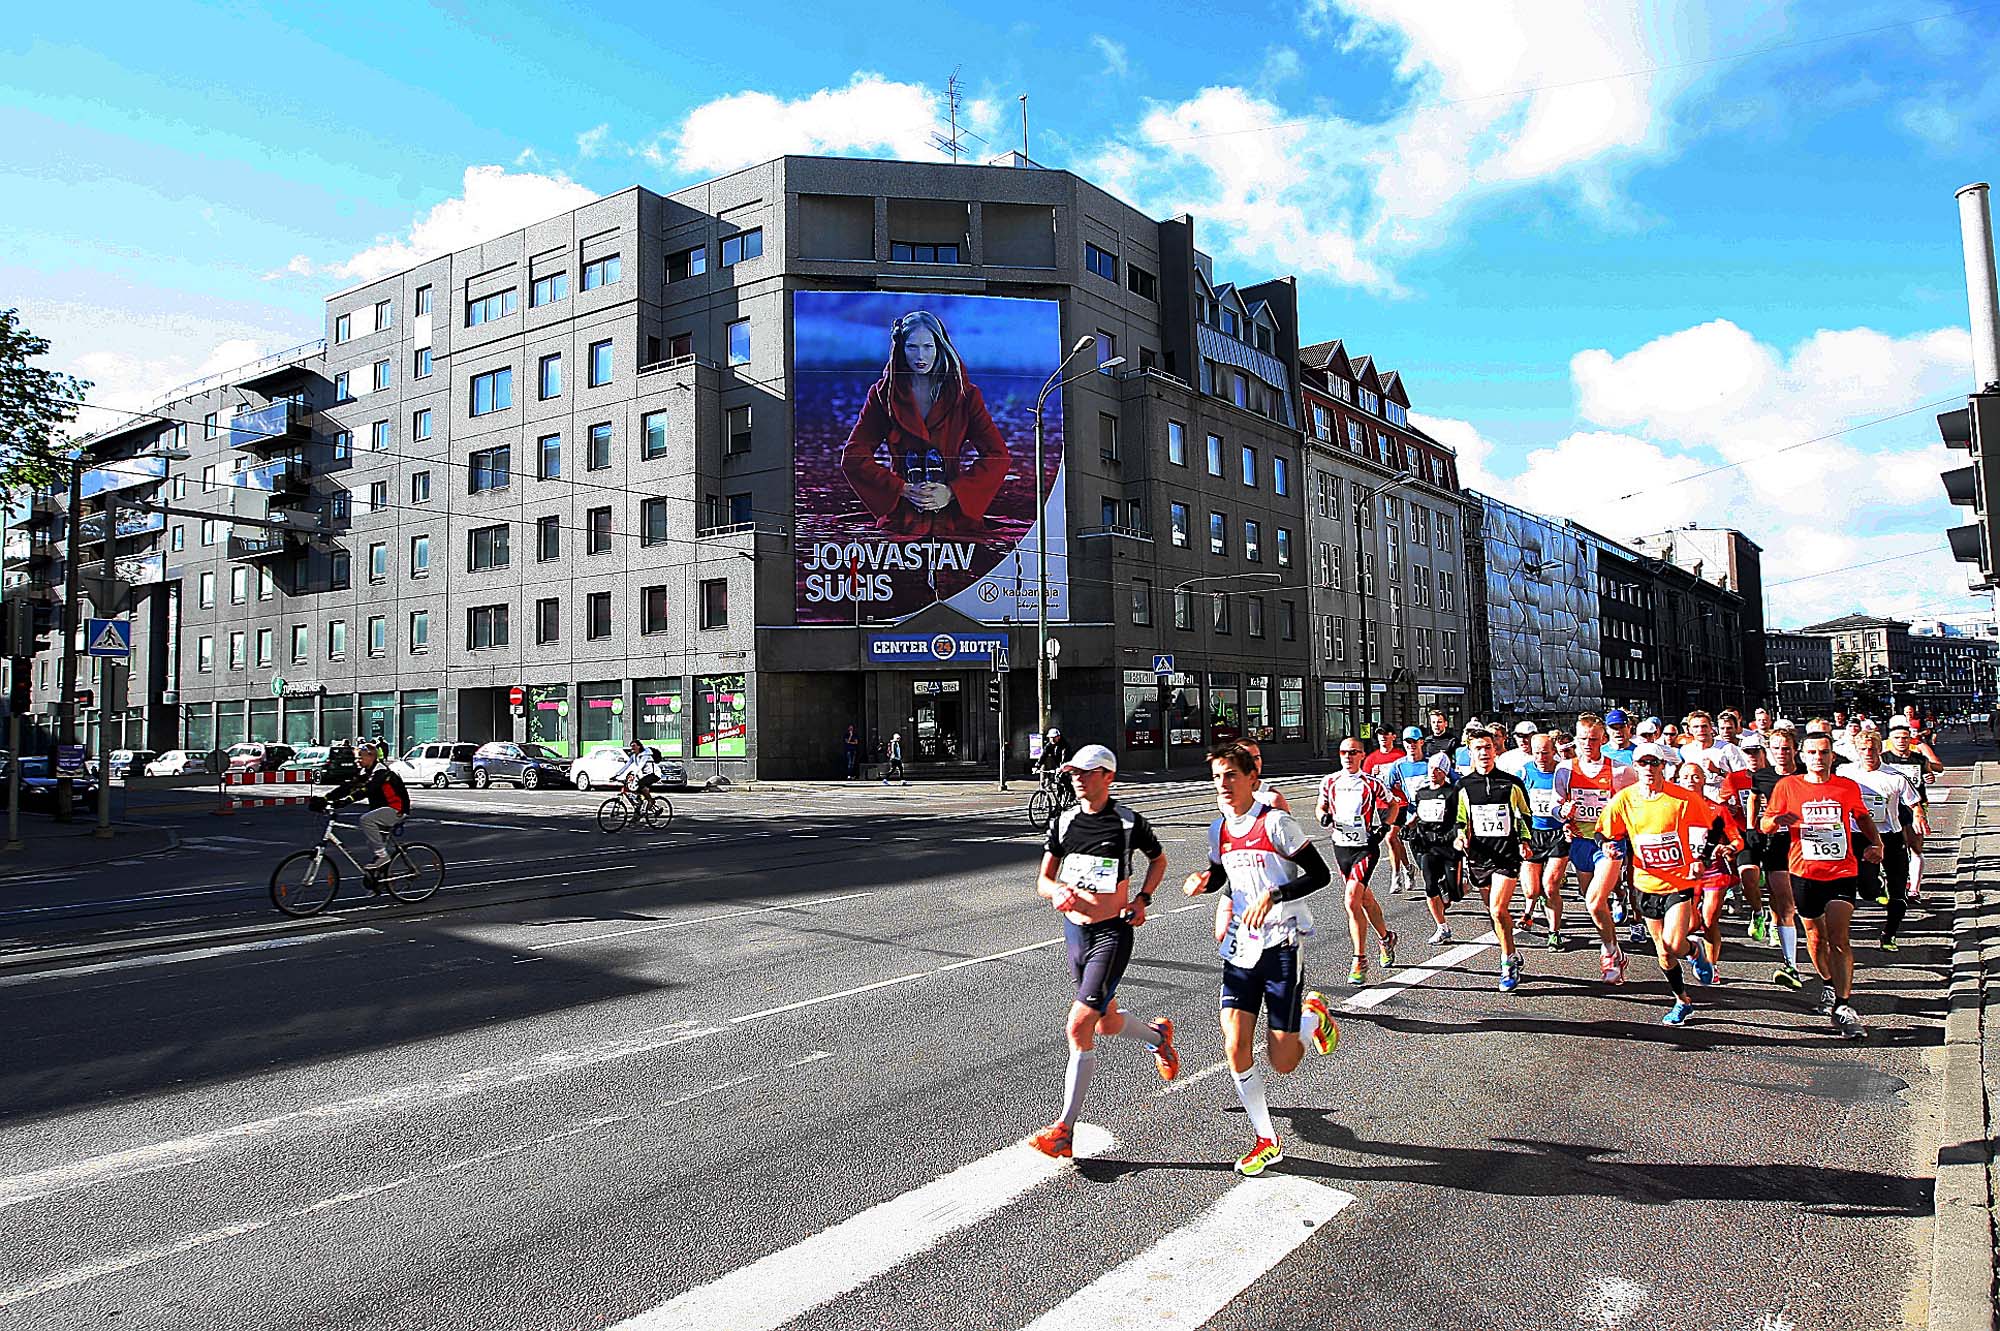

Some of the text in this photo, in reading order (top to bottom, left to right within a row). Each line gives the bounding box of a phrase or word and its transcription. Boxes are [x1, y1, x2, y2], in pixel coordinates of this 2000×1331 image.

[803, 543, 976, 571] JOOVASTAV
[805, 573, 894, 602] SÜGIS
[873, 641, 929, 654] CENTER
[936, 642, 952, 652] 24
[1482, 822, 1504, 832] 174
[1644, 847, 1680, 864] 3:00
[1813, 842, 1841, 856] 163
